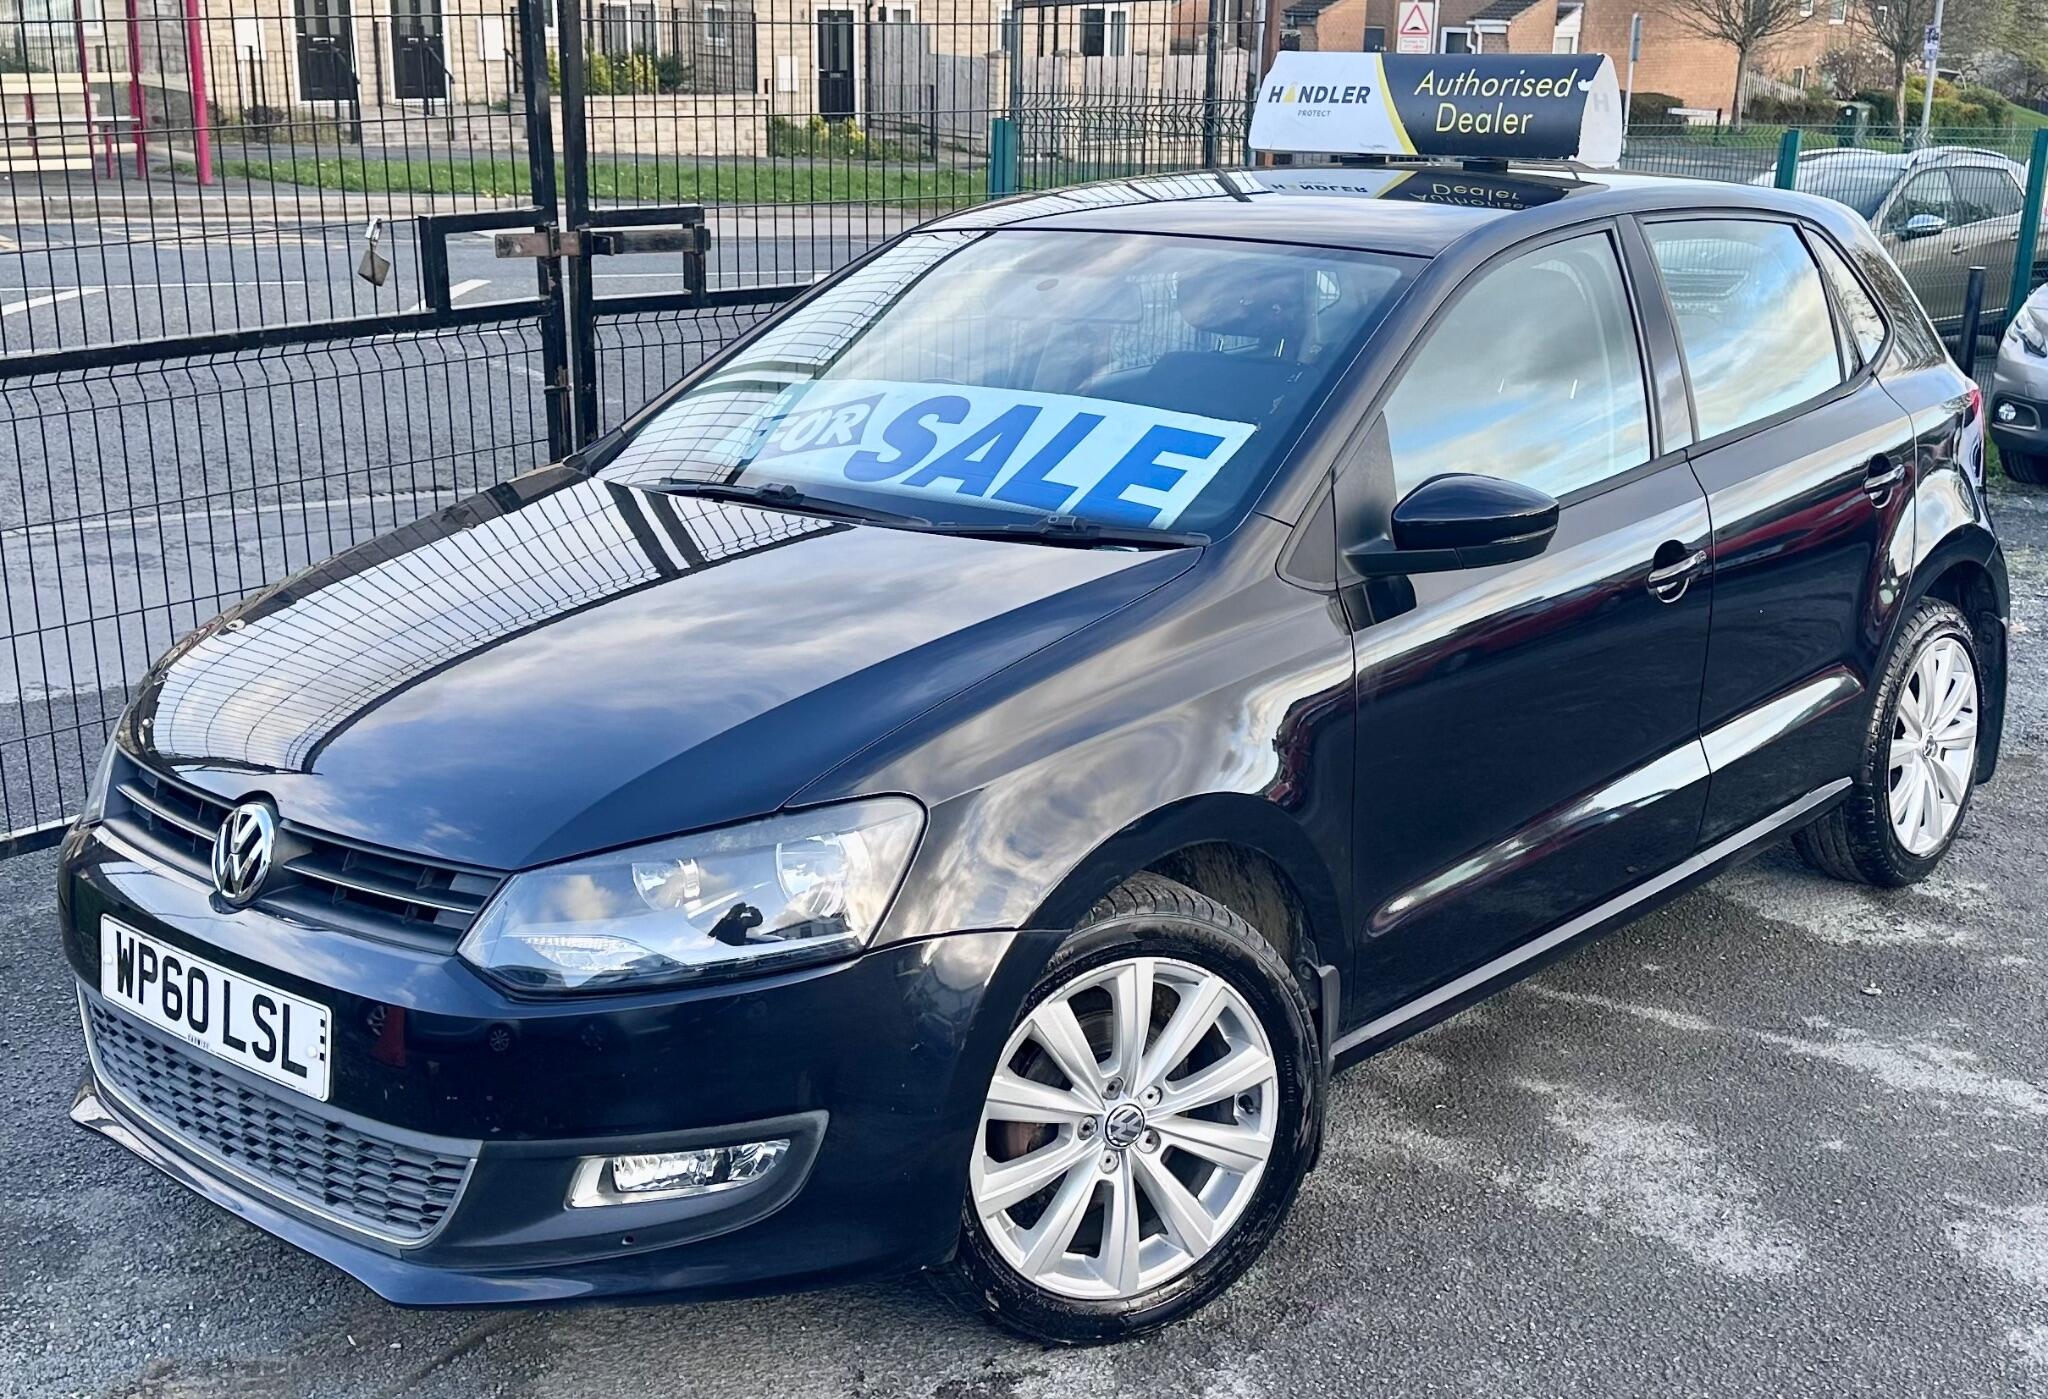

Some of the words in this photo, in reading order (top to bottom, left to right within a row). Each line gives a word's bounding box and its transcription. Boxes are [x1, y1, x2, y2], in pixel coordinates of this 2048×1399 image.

[1413, 68, 1579, 99] Authorised
[1297, 109, 1332, 118] PROTECT
[1593, 92, 1610, 112] H
[1435, 102, 1533, 134] Dealer
[758, 403, 871, 451] FOR
[844, 396, 1225, 529] SALE
[115, 931, 209, 1034] WP60
[223, 979, 307, 1079] LSL
